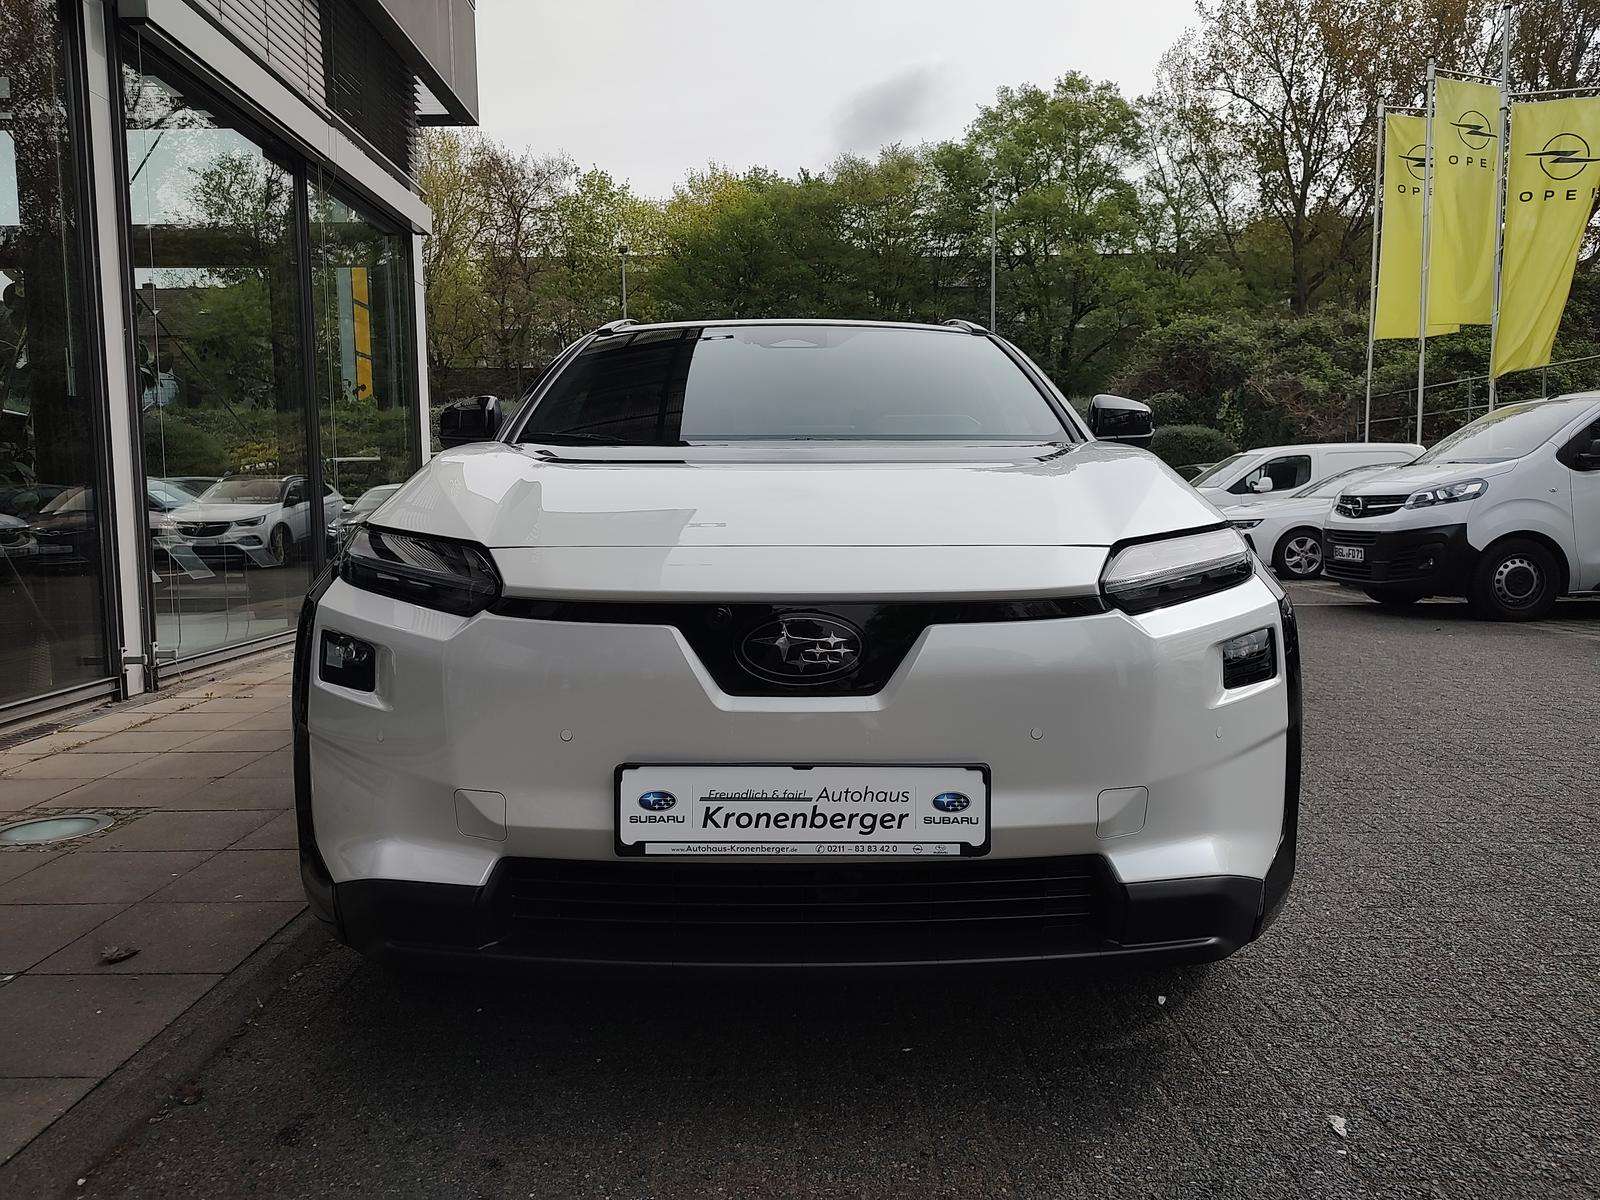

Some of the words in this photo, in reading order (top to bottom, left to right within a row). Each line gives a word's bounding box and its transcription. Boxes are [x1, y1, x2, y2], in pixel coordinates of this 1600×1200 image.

[1449, 155, 1495, 171] OPE
[708, 789, 768, 799] Freundlich
[772, 790, 779, 799] &
[782, 789, 807, 800] fair!
[816, 785, 910, 803] Autohaus
[629, 815, 685, 824] SUBARU
[702, 805, 909, 835] Kronenberger
[923, 816, 979, 825] SUBARU
[670, 844, 798, 854] www.Autohaus-Kronenberger.de
[827, 845, 845, 853] 0211
[854, 845, 865, 853] 83
[867, 845, 878, 853] 83
[879, 845, 890, 853] 42
